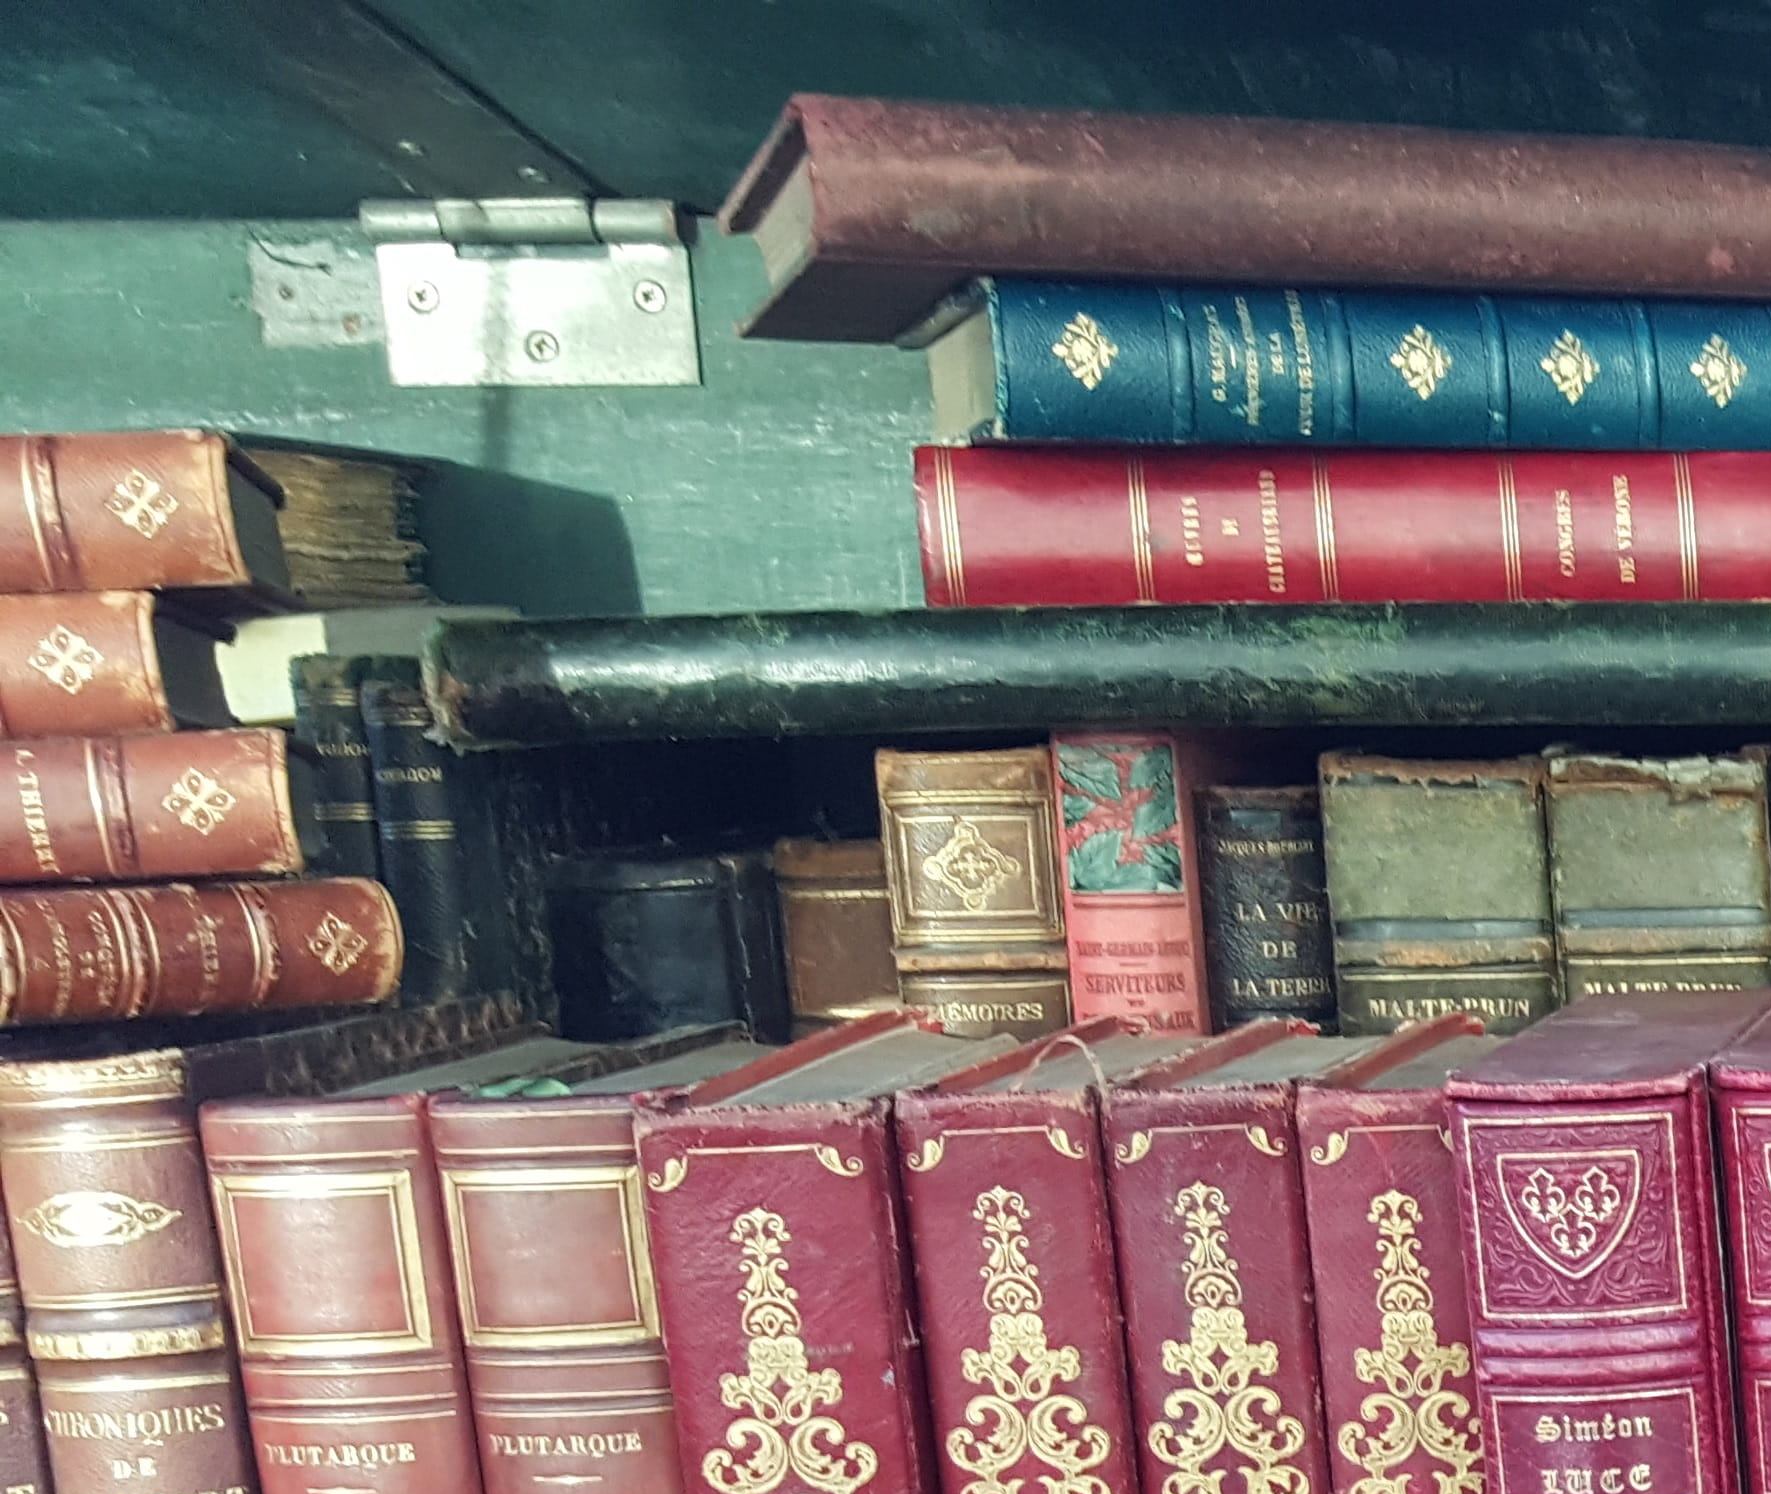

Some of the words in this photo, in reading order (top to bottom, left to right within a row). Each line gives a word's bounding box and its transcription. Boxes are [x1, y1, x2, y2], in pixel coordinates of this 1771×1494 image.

[1619, 557, 1636, 583] DE
[1237, 903, 1266, 921] LA
[1262, 941, 1297, 959] DE
[1085, 972, 1186, 995] SERVITEURS
[1232, 977, 1260, 997] LA
[44, 1404, 226, 1447] CHRONIQUES
[1533, 1412, 1654, 1444] Siméon
[264, 1442, 416, 1471] PLUTARQUE
[489, 1431, 643, 1458] PLUTARQUE
[111, 1456, 158, 1480] DE
